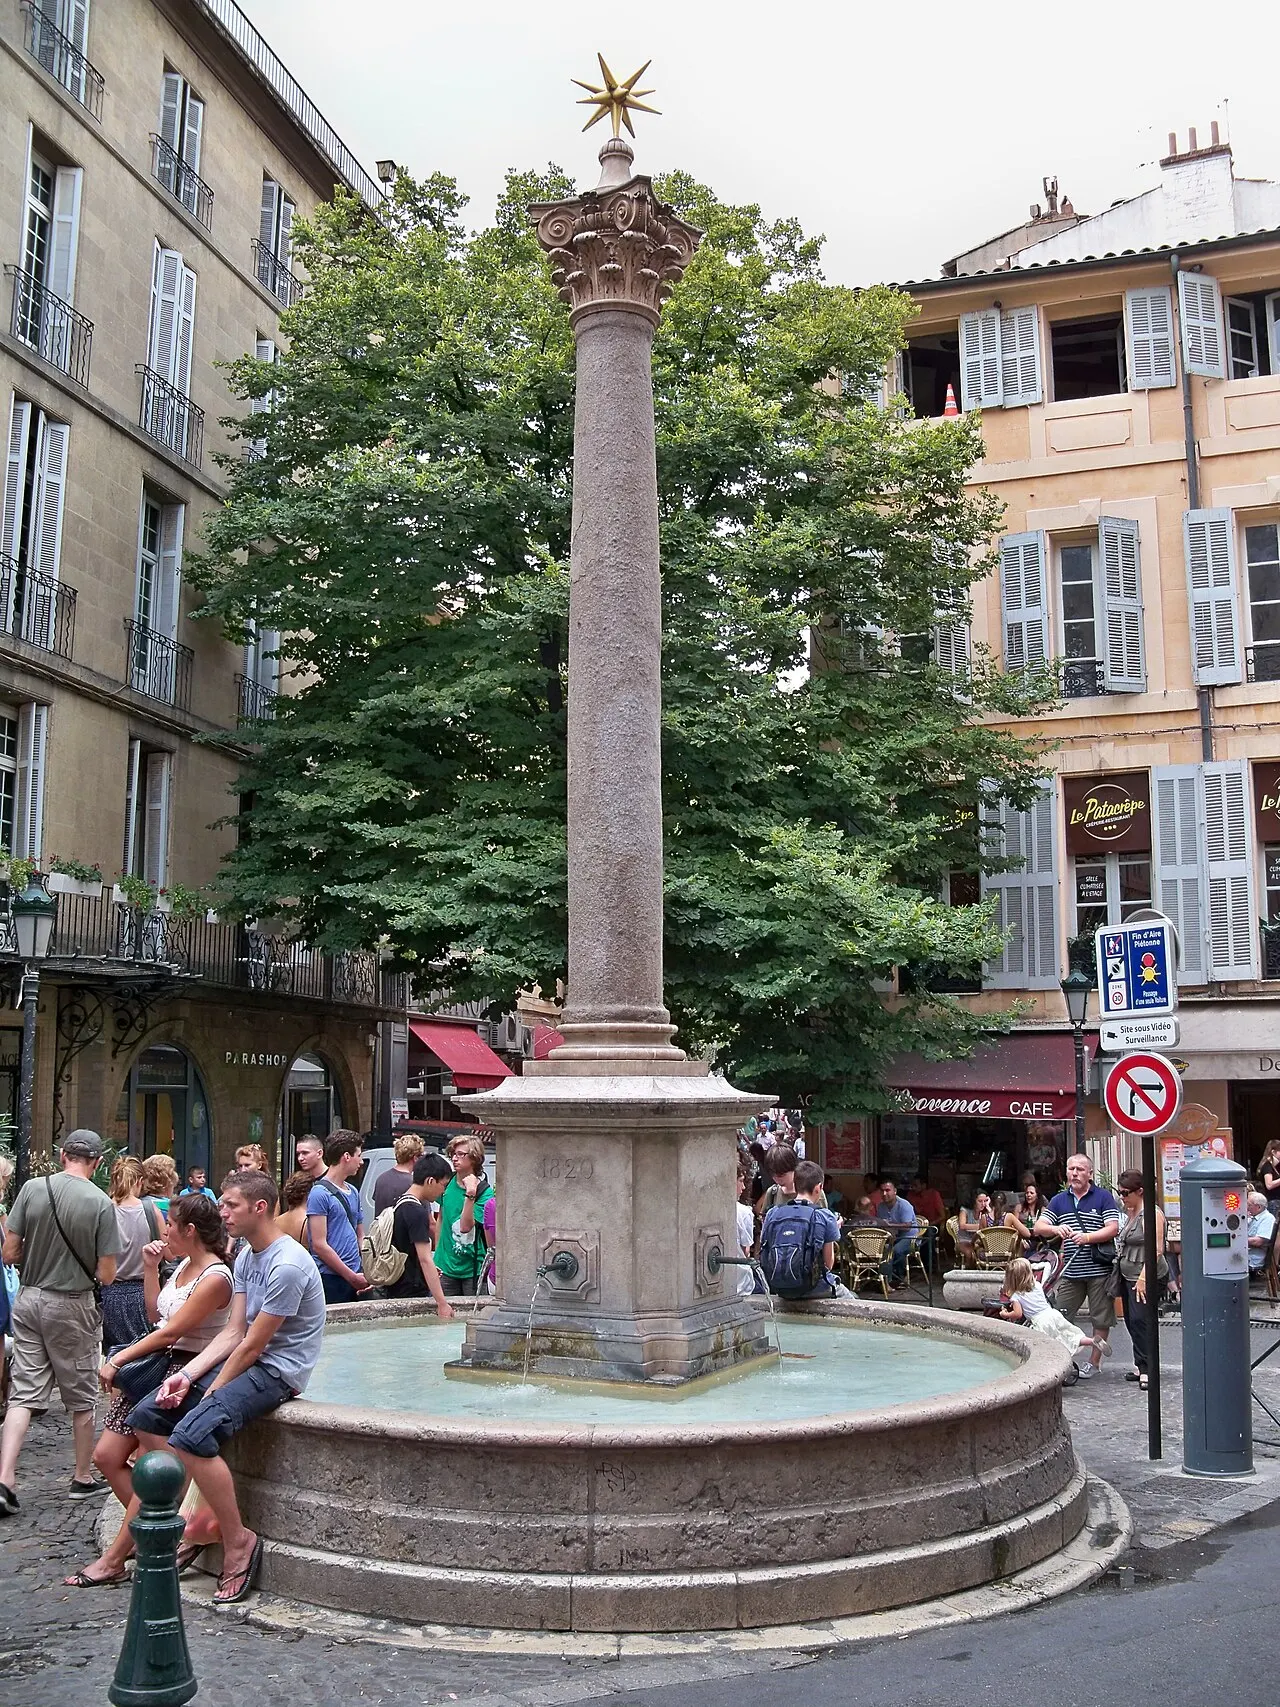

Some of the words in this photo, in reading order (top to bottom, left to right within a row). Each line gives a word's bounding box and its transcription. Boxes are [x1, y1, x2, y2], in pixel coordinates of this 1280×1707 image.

[1261, 794, 1276, 811] Le
[1070, 808, 1084, 825] Le
[1084, 798, 1145, 822] Patacrêpe
[1132, 932, 1142, 940] Fin
[1143, 930, 1162, 939] d'Aire
[1134, 939, 1161, 949] Piétonne
[1120, 1024, 1134, 1034] Site
[1134, 1023, 1150, 1032] sous
[1151, 1021, 1172, 1031] Vidéo
[1125, 1033, 1168, 1044] Surveillance
[225, 1051, 288, 1066] PARASHOP
[898, 1088, 991, 1114] ovence
[1009, 1101, 1053, 1116] CAFE
[541, 1158, 594, 1180] 1820
